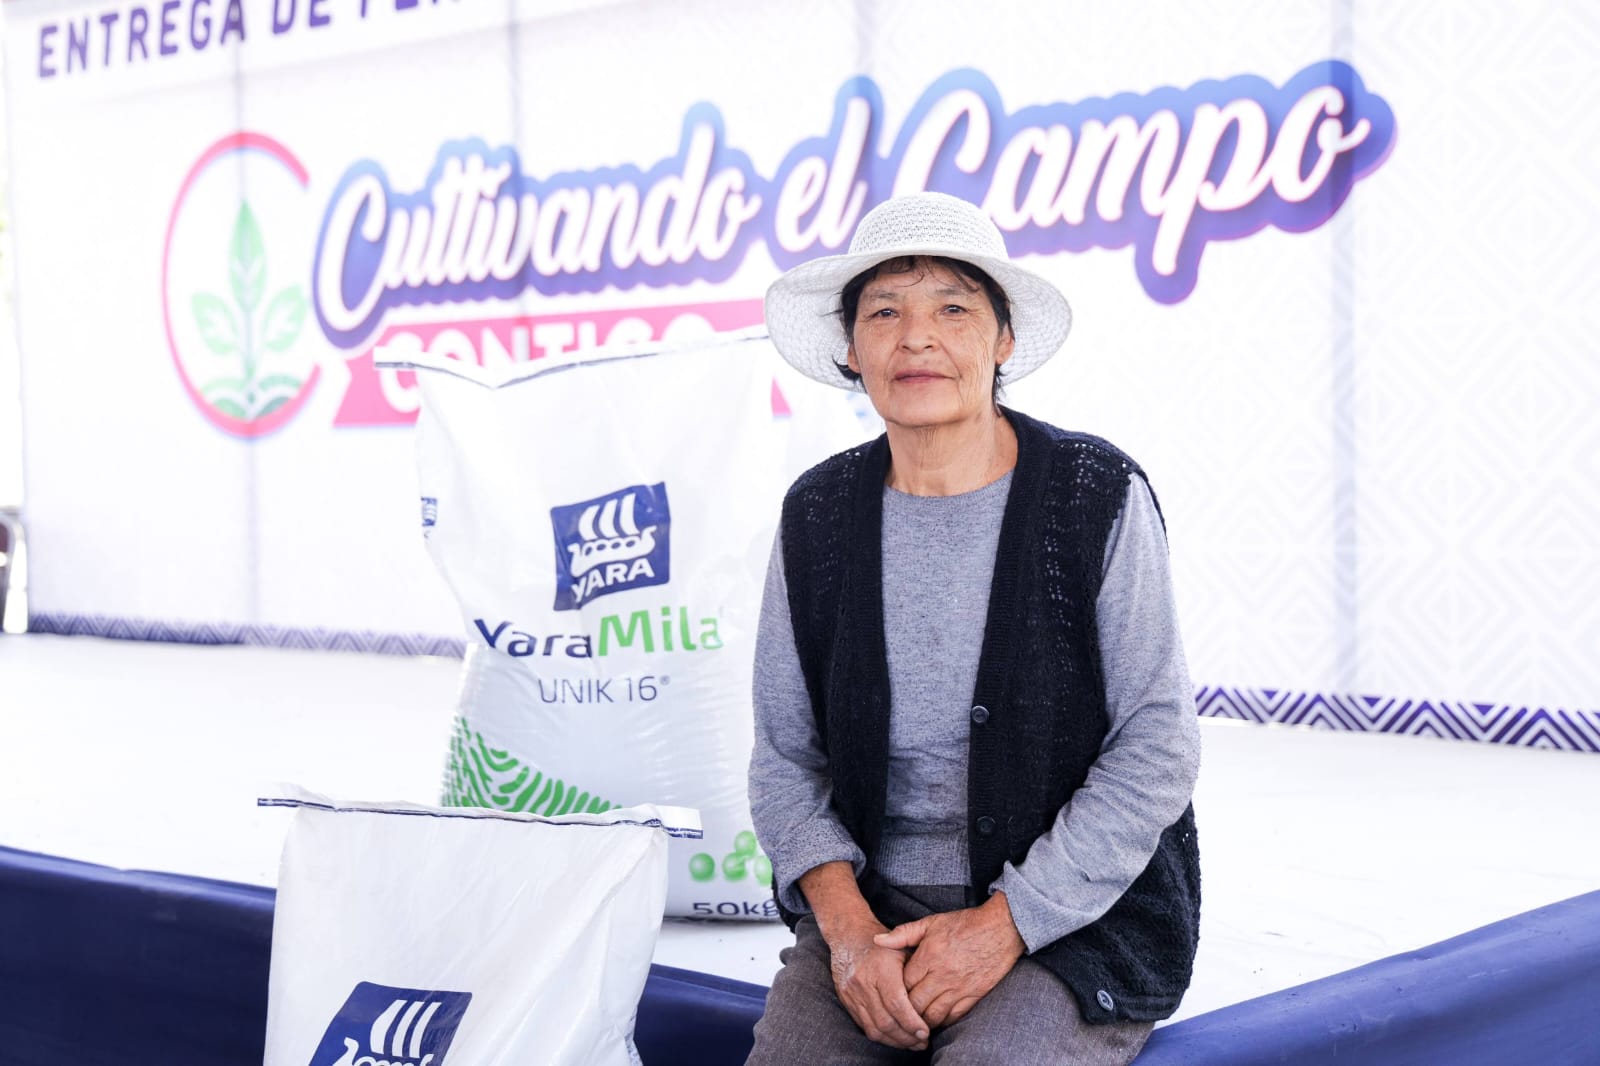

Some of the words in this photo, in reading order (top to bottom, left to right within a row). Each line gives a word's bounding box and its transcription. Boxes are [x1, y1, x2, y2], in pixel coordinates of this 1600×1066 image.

[38, 0, 246, 78] ENTREGA
[317, 122, 762, 332] Cultivando
[774, 97, 869, 252] el
[893, 86, 1371, 276] Campo
[571, 557, 656, 603] YARA
[473, 605, 724, 659] YaraMila
[538, 677, 615, 704] UNIK
[692, 899, 779, 917] 50kg
